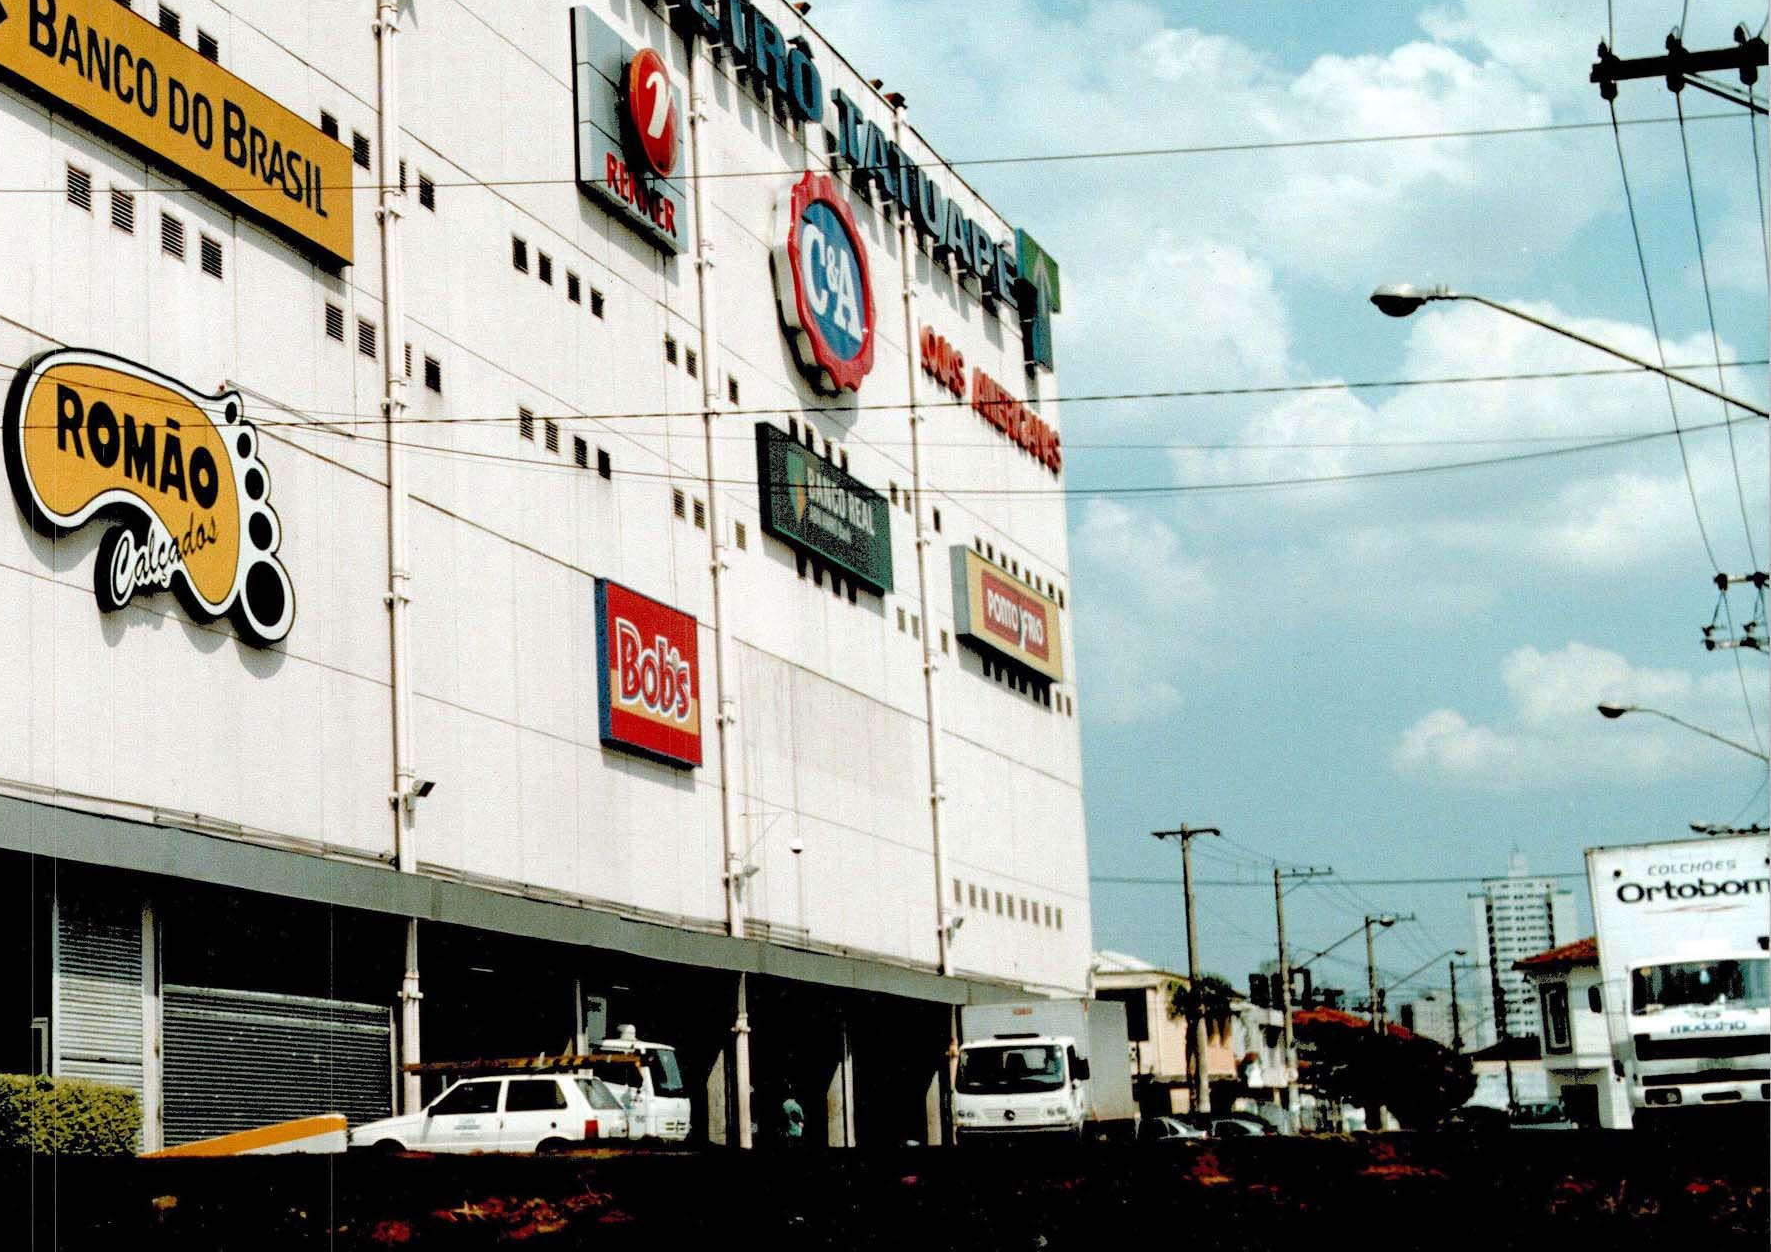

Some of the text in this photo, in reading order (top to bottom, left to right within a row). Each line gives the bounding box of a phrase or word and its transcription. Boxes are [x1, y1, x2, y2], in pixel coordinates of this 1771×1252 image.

[168, 77, 213, 151] DO
[223, 99, 329, 218] BRASIL
[606, 152, 677, 238] RENNER
[802, 223, 863, 343] C&A
[56, 383, 220, 510] ROMÃO
[113, 513, 220, 603] Calçados
[617, 619, 691, 722] Bob's
